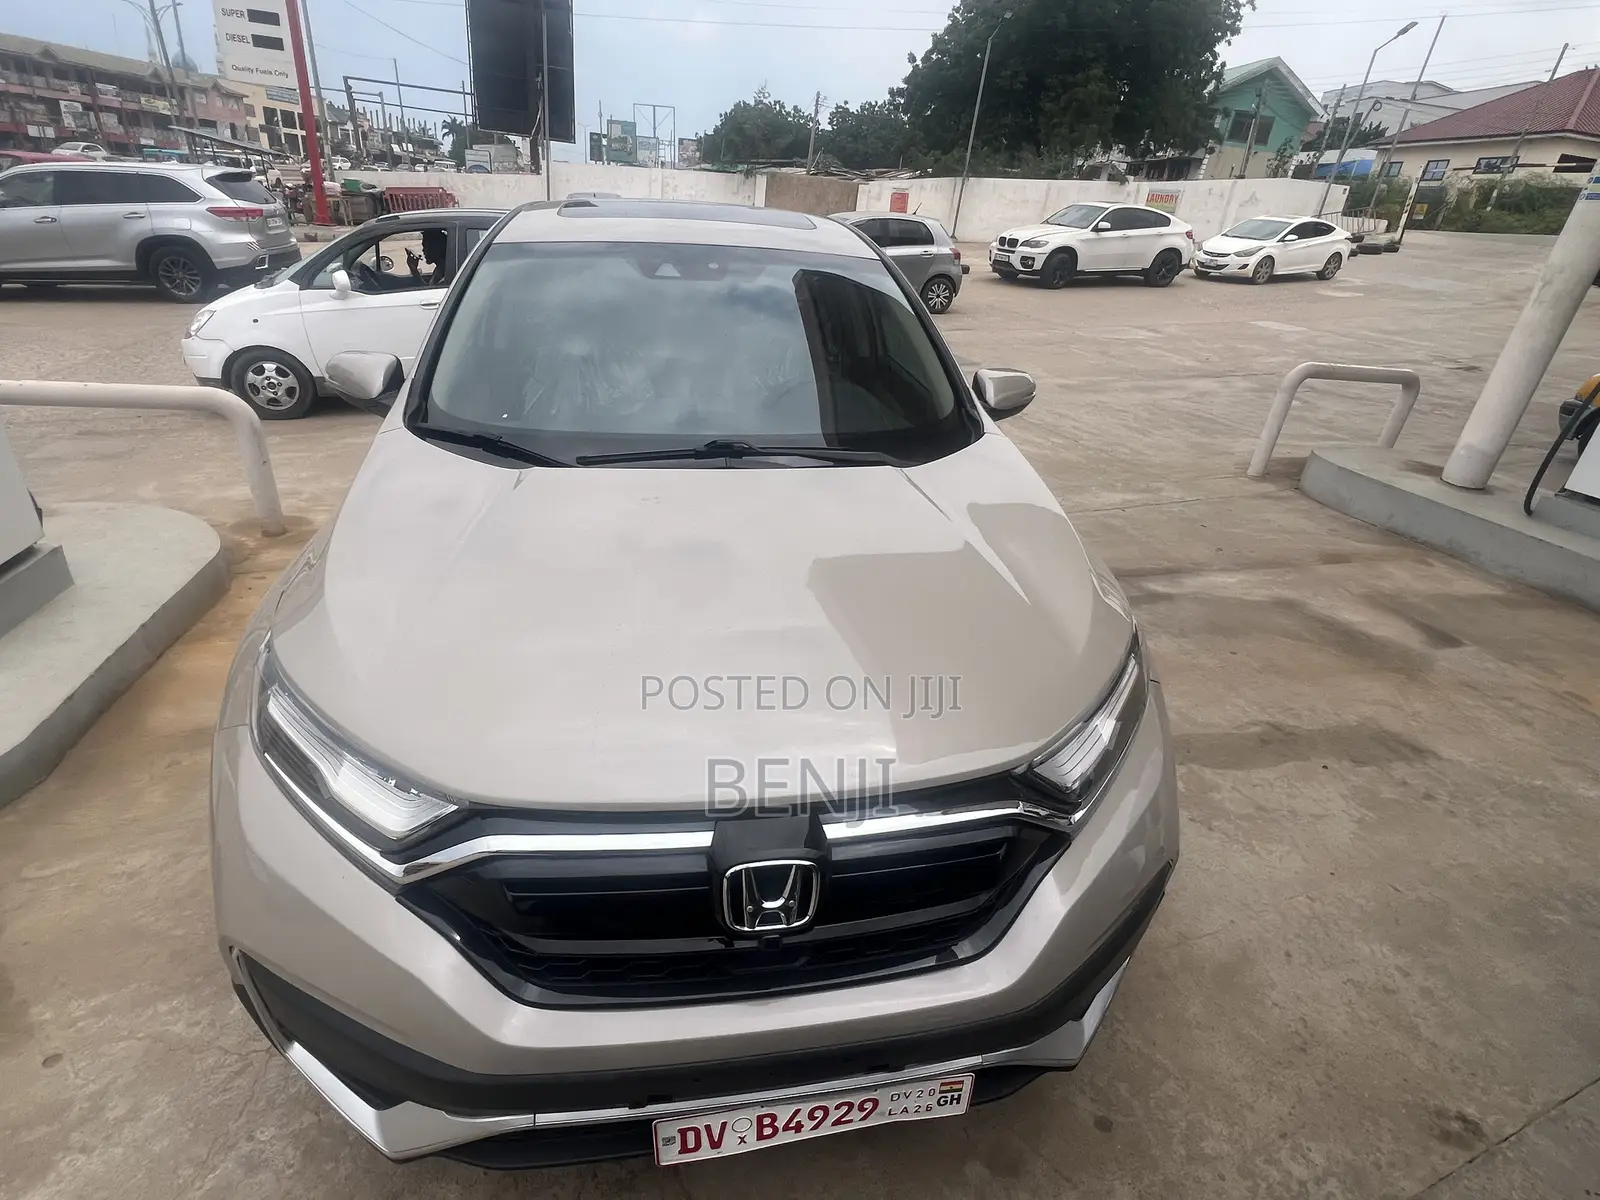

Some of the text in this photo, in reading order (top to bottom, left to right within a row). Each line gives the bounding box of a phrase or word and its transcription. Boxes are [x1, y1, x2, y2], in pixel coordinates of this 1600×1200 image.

[221, 8, 246, 19] SUPER
[225, 33, 251, 44] DIESEL
[231, 64, 289, 79] Quality Fuels Only
[1146, 193, 1179, 204] LAUNDRY
[936, 1093, 963, 1107] GH
[677, 1121, 728, 1155] DV
[756, 1097, 880, 1142] B4929
